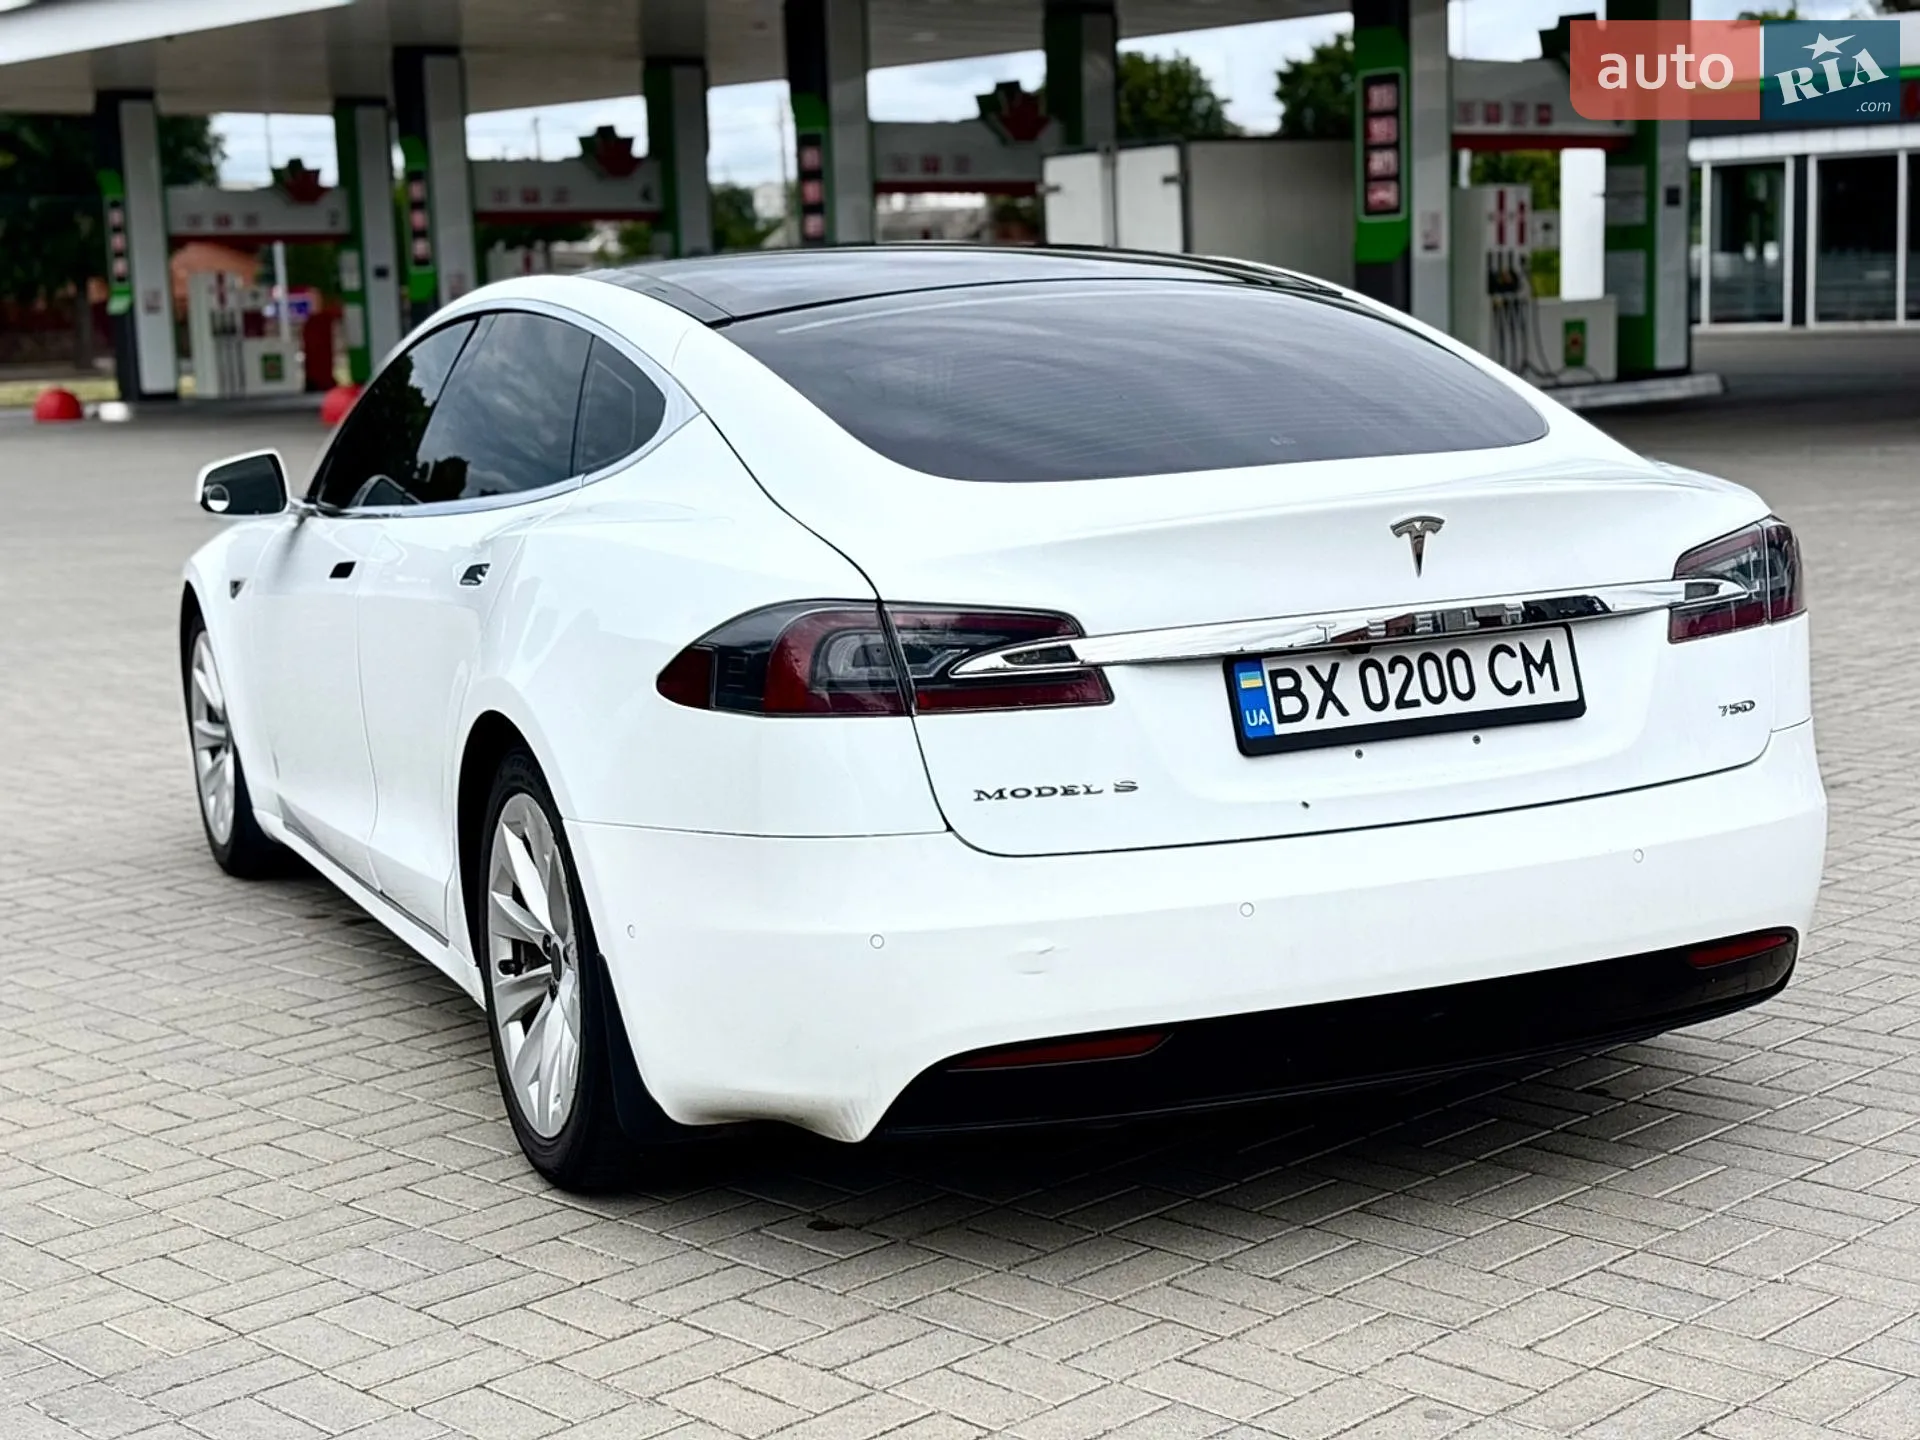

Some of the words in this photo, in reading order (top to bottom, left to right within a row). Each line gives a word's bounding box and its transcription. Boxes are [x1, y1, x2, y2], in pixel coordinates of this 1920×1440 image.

[1268, 662, 1350, 724] BX
[1358, 648, 1476, 712] 0200
[1488, 639, 1560, 696] CM
[1718, 700, 1755, 717] 75D
[1246, 712, 1270, 728] UA
[973, 784, 1104, 802] MODEL
[1113, 780, 1139, 793] S
